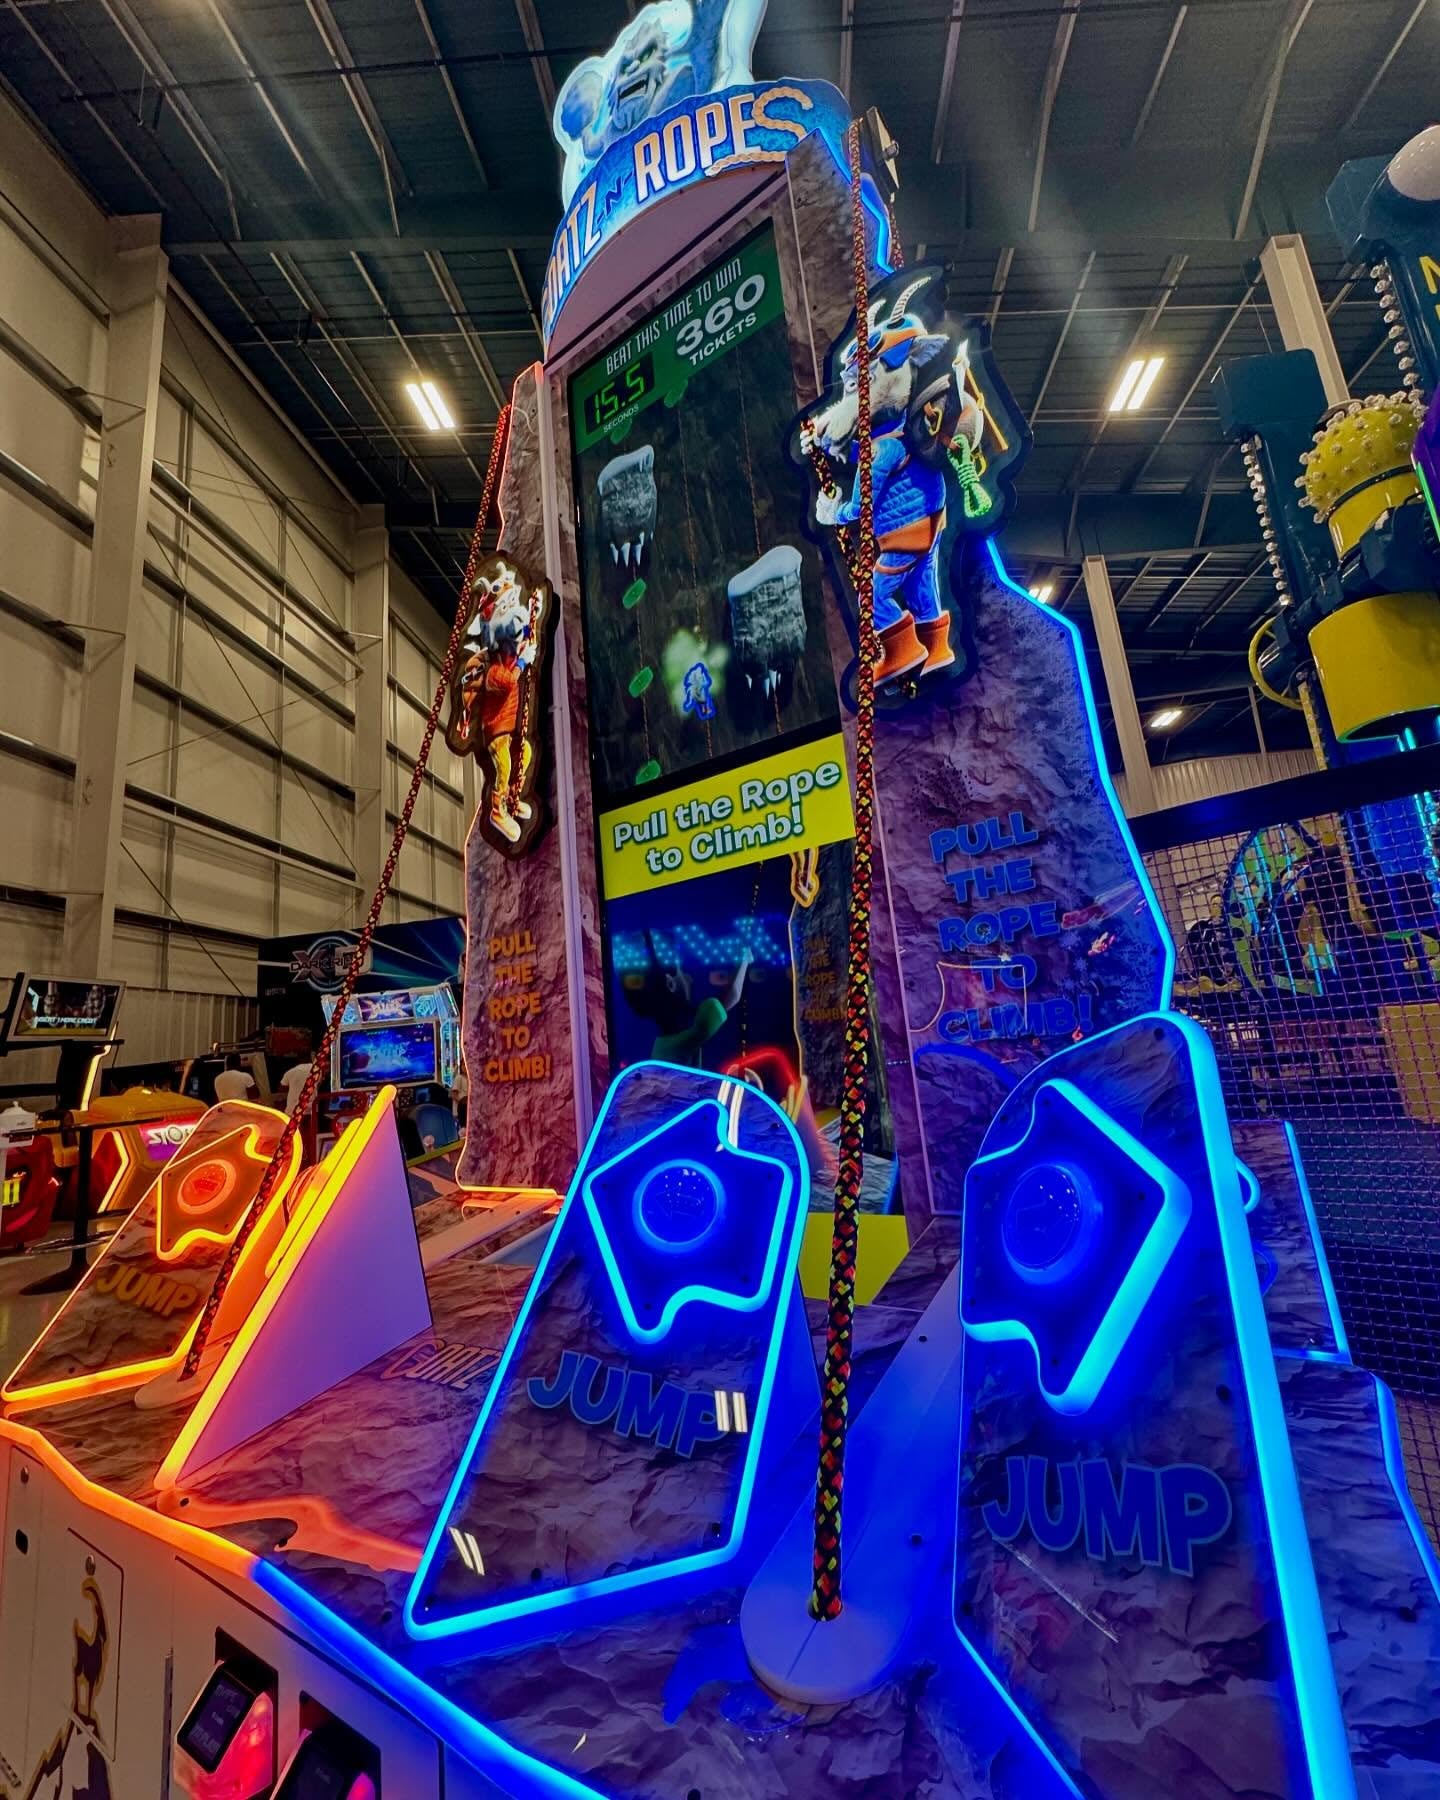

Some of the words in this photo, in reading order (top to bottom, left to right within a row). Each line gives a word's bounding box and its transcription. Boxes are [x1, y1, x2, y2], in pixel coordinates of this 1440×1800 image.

[633, 86, 814, 203] ROPES
[605, 339, 632, 376] BEAT
[636, 320, 661, 353] THIS
[663, 294, 693, 332] TIME
[696, 280, 712, 306] TO
[715, 257, 742, 290] WIN
[675, 273, 766, 357] 360
[688, 312, 757, 367] TICKETS
[594, 362, 645, 425] 15.5
[603, 403, 640, 433] SECONDS
[613, 808, 668, 850] Pull
[674, 798, 733, 831] the
[740, 760, 842, 812] Rope
[645, 846, 683, 875] to
[689, 804, 805, 862] Climb!
[928, 811, 1039, 864] PULL
[943, 857, 1036, 904] THE
[487, 930, 537, 961] PULL
[936, 901, 1061, 953] ROPE
[494, 961, 535, 986] THE
[969, 953, 1038, 993] TO
[487, 991, 543, 1021] ROPE
[936, 993, 1094, 1044] CLIMB!
[501, 1025, 531, 1049] TO
[484, 1054, 550, 1083] CLIMB!
[96, 1263, 199, 1317] JUMP
[526, 1350, 731, 1459] JUMP
[981, 1454, 1233, 1578] JUMP
